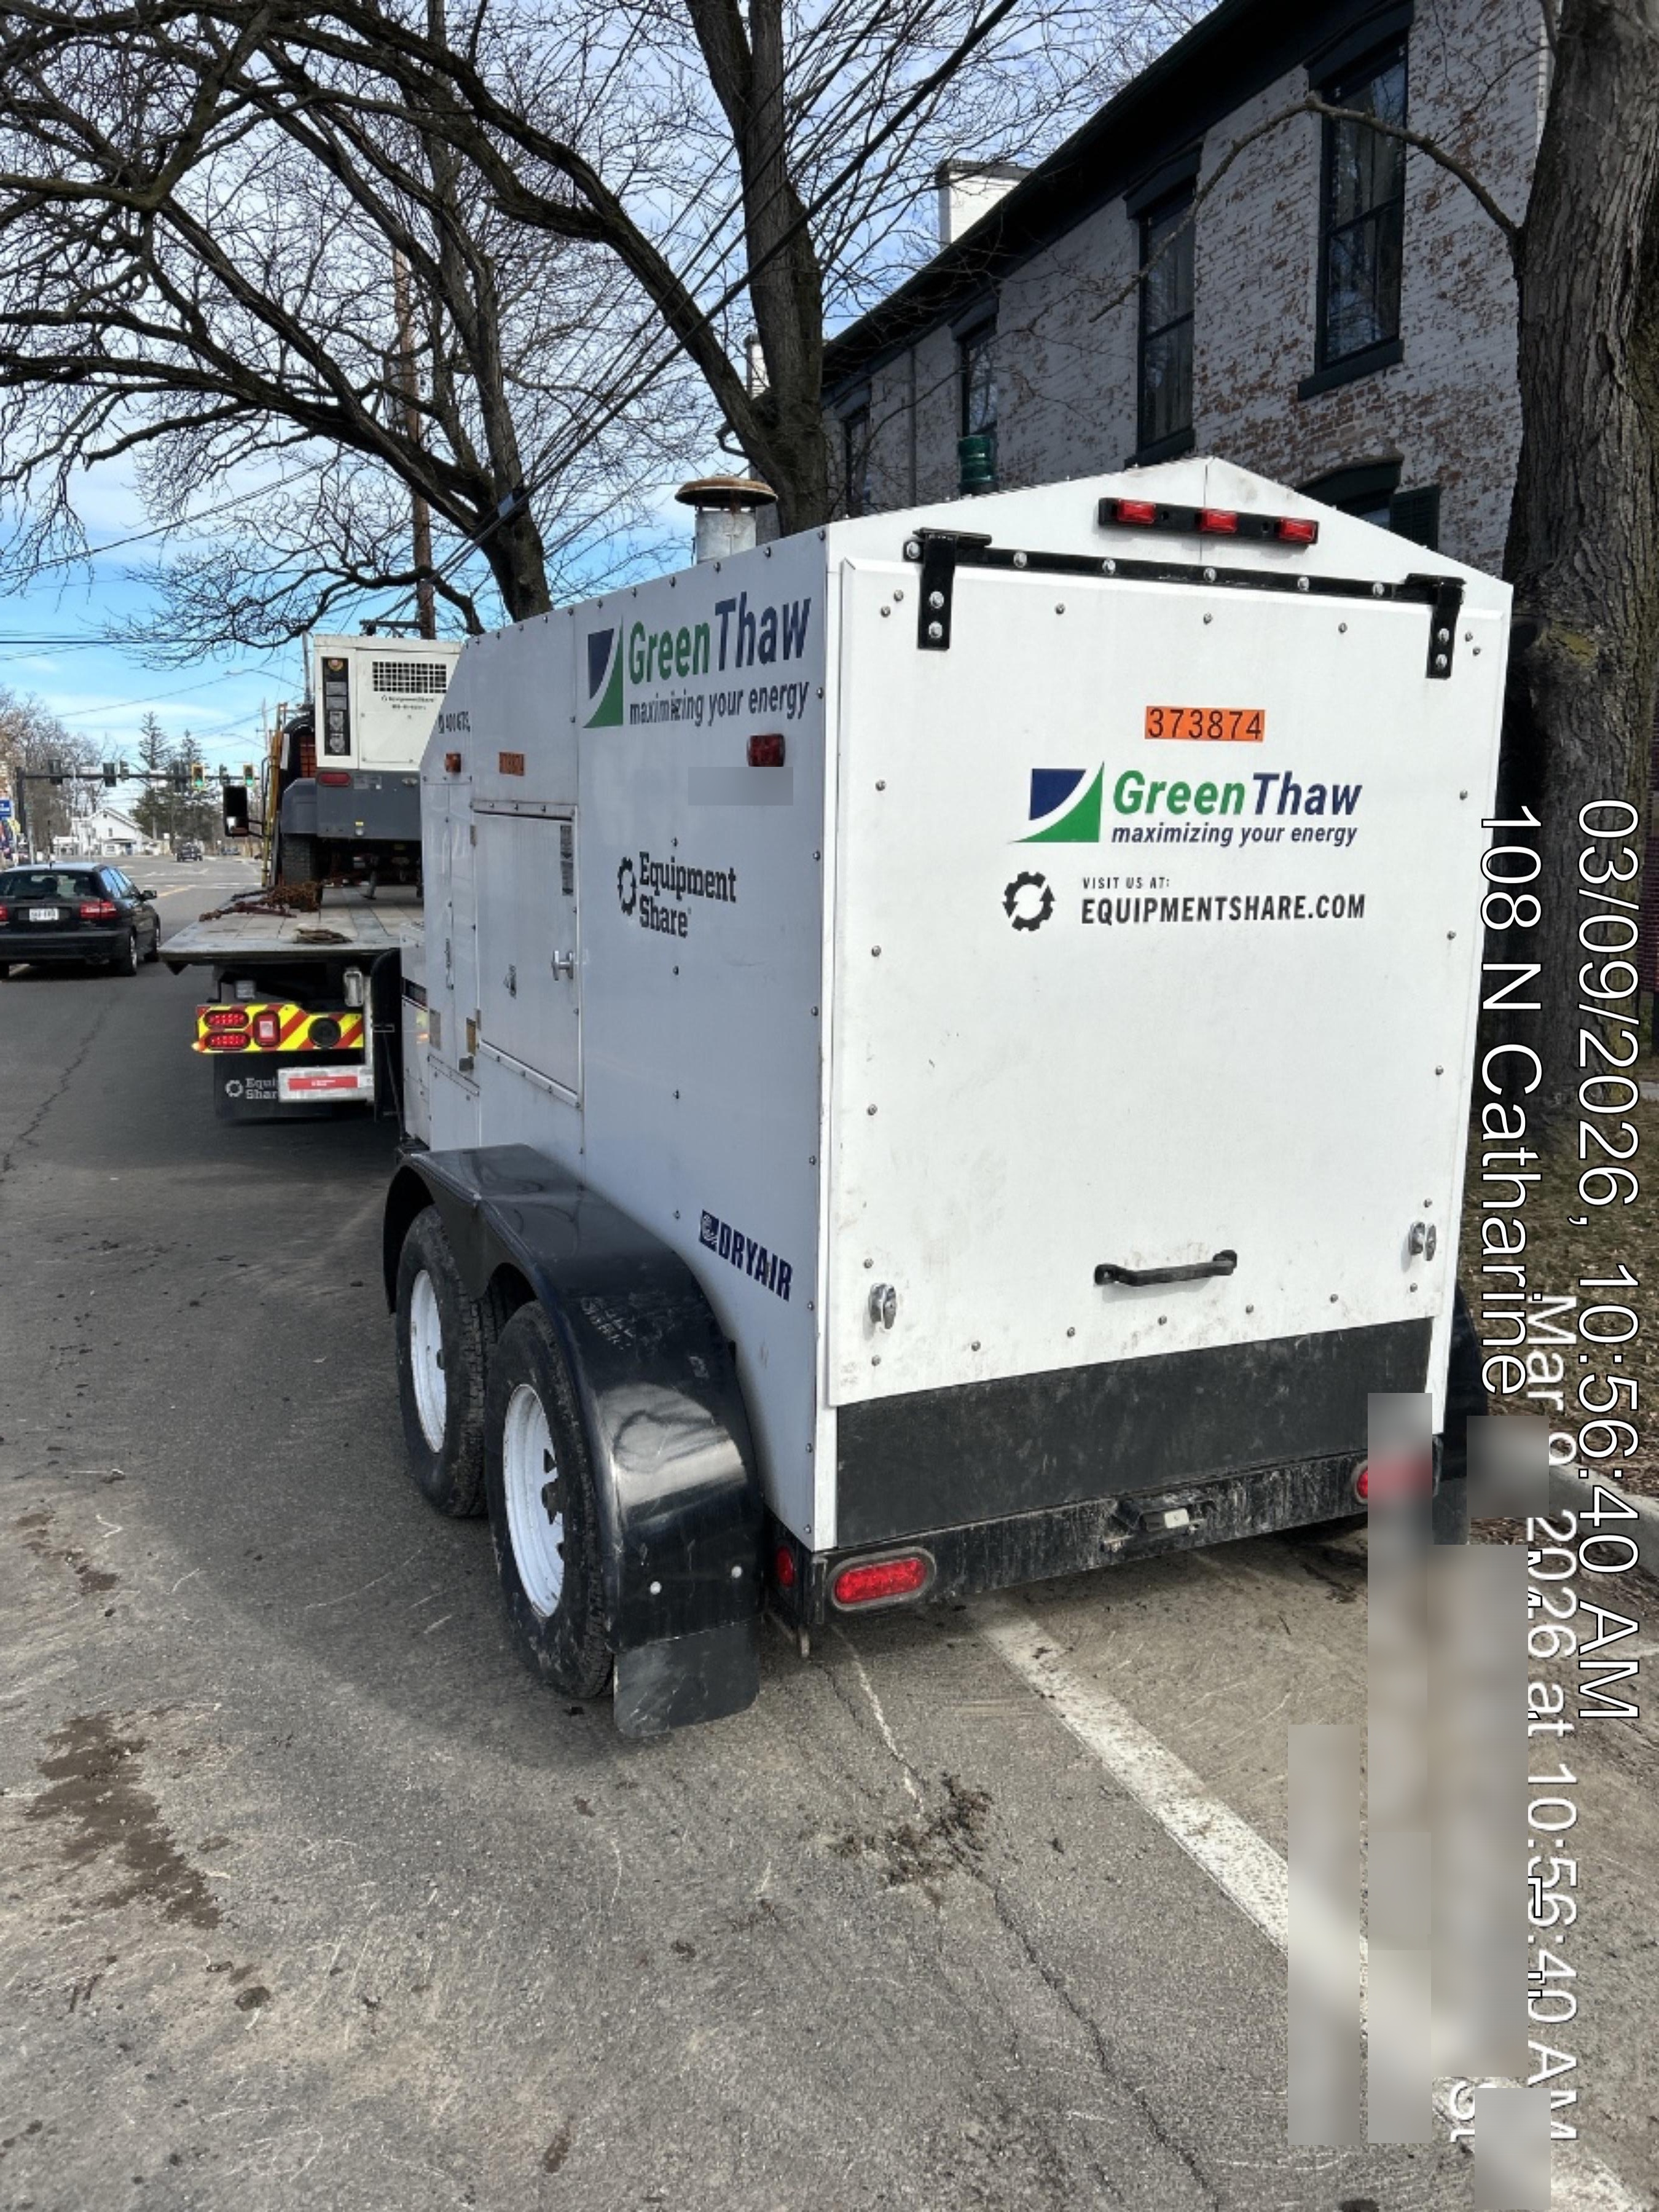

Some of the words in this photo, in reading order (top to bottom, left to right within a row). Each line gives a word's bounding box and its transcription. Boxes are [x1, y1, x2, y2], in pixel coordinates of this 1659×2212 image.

[629, 591, 811, 684] GreenThaw
[629, 688, 705, 726] maximizing
[708, 689, 743, 726] your
[748, 681, 810, 720] energy
[1147, 708, 1263, 740] 373874
[1113, 769, 1362, 816] GreenThaw
[1111, 822, 1233, 847] maximizing
[1238, 825, 1285, 848] your
[1291, 825, 1357, 847] energy
[639, 851, 737, 903] Equipment
[1082, 876, 1120, 890] VISIT
[1126, 876, 1143, 889] US
[1150, 876, 1171, 889] AT:
[639, 893, 688, 939] Share
[1081, 893, 1365, 926] EQUIPMENTSHARE.COM
[245, 1076, 276, 1090] Equi
[246, 1089, 278, 1100] Shar
[718, 1220, 793, 1303] DRYAIR
